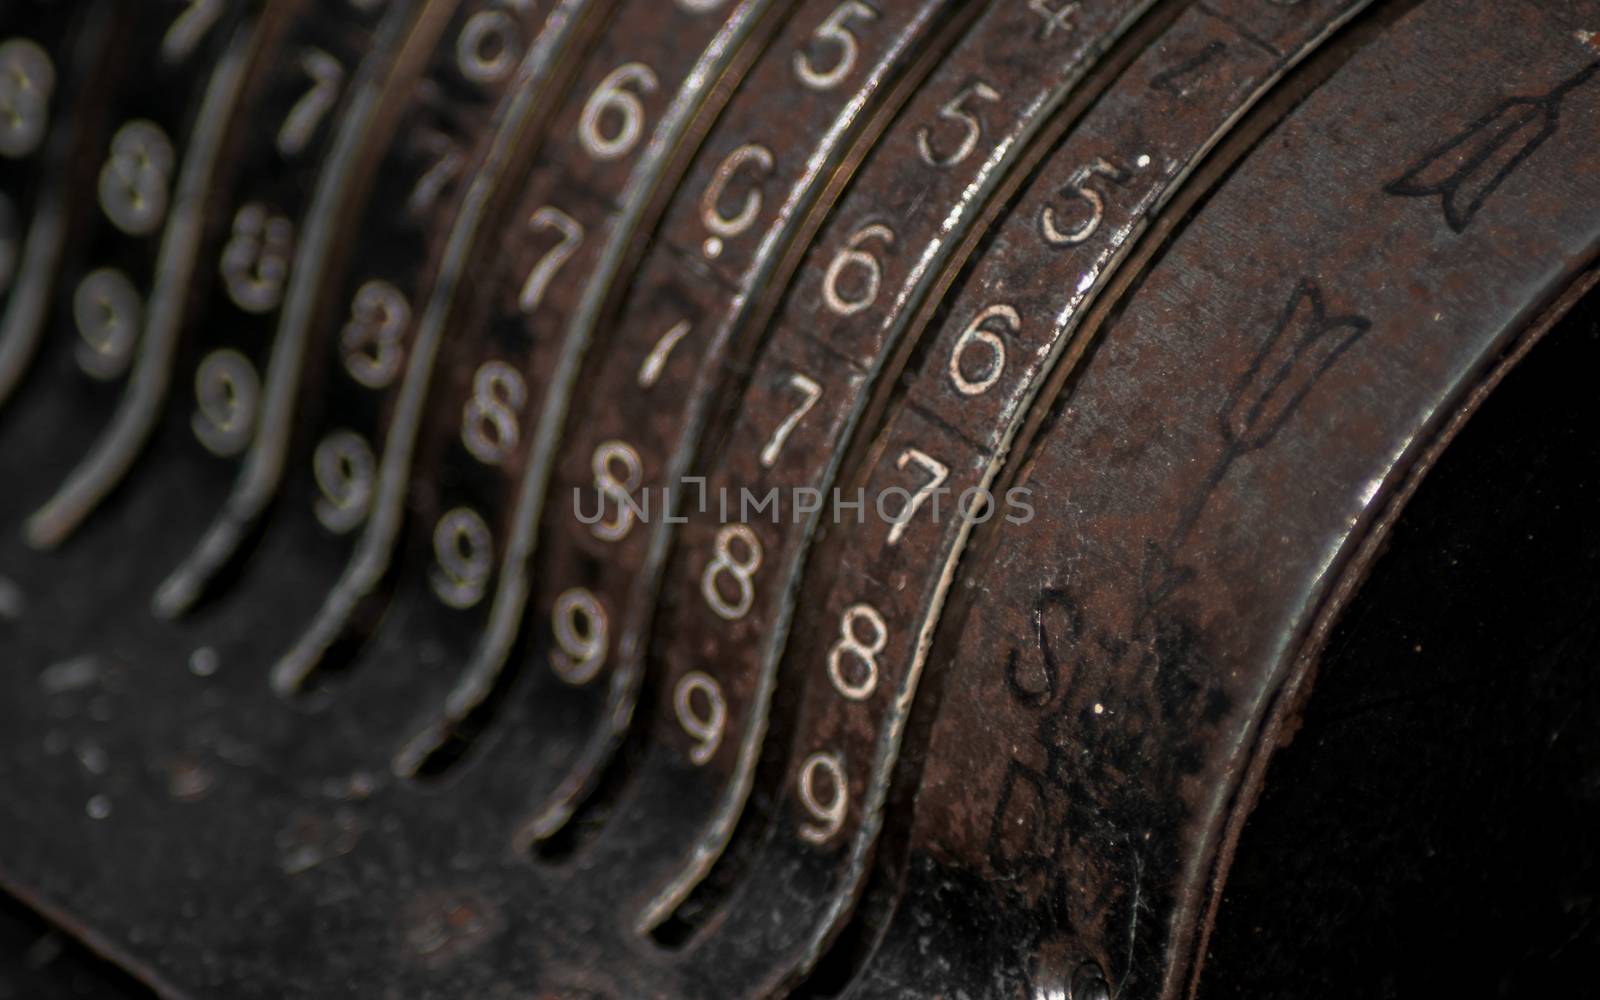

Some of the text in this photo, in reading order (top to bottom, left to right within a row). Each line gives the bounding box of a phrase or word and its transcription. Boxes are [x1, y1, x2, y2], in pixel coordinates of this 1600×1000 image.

[794, 0, 877, 89] 5
[277, 46, 343, 156] 7
[579, 63, 659, 159] 6
[917, 81, 1000, 167] 5
[98, 118, 175, 236] 8
[1040, 157, 1130, 247] 5
[519, 206, 584, 312] 7
[823, 223, 895, 315] 6
[73, 267, 141, 381] 9
[949, 304, 1021, 395] 6
[191, 348, 262, 457] 9
[462, 361, 527, 465] 8
[760, 374, 821, 467] 7
[312, 427, 377, 534] 9
[591, 440, 643, 541] 8
[887, 449, 948, 544] 7
[429, 505, 493, 608] 9
[703, 523, 762, 619] 8
[550, 587, 608, 685] 9
[828, 604, 888, 700] 8
[674, 671, 727, 766] 9
[799, 752, 848, 845] 9
